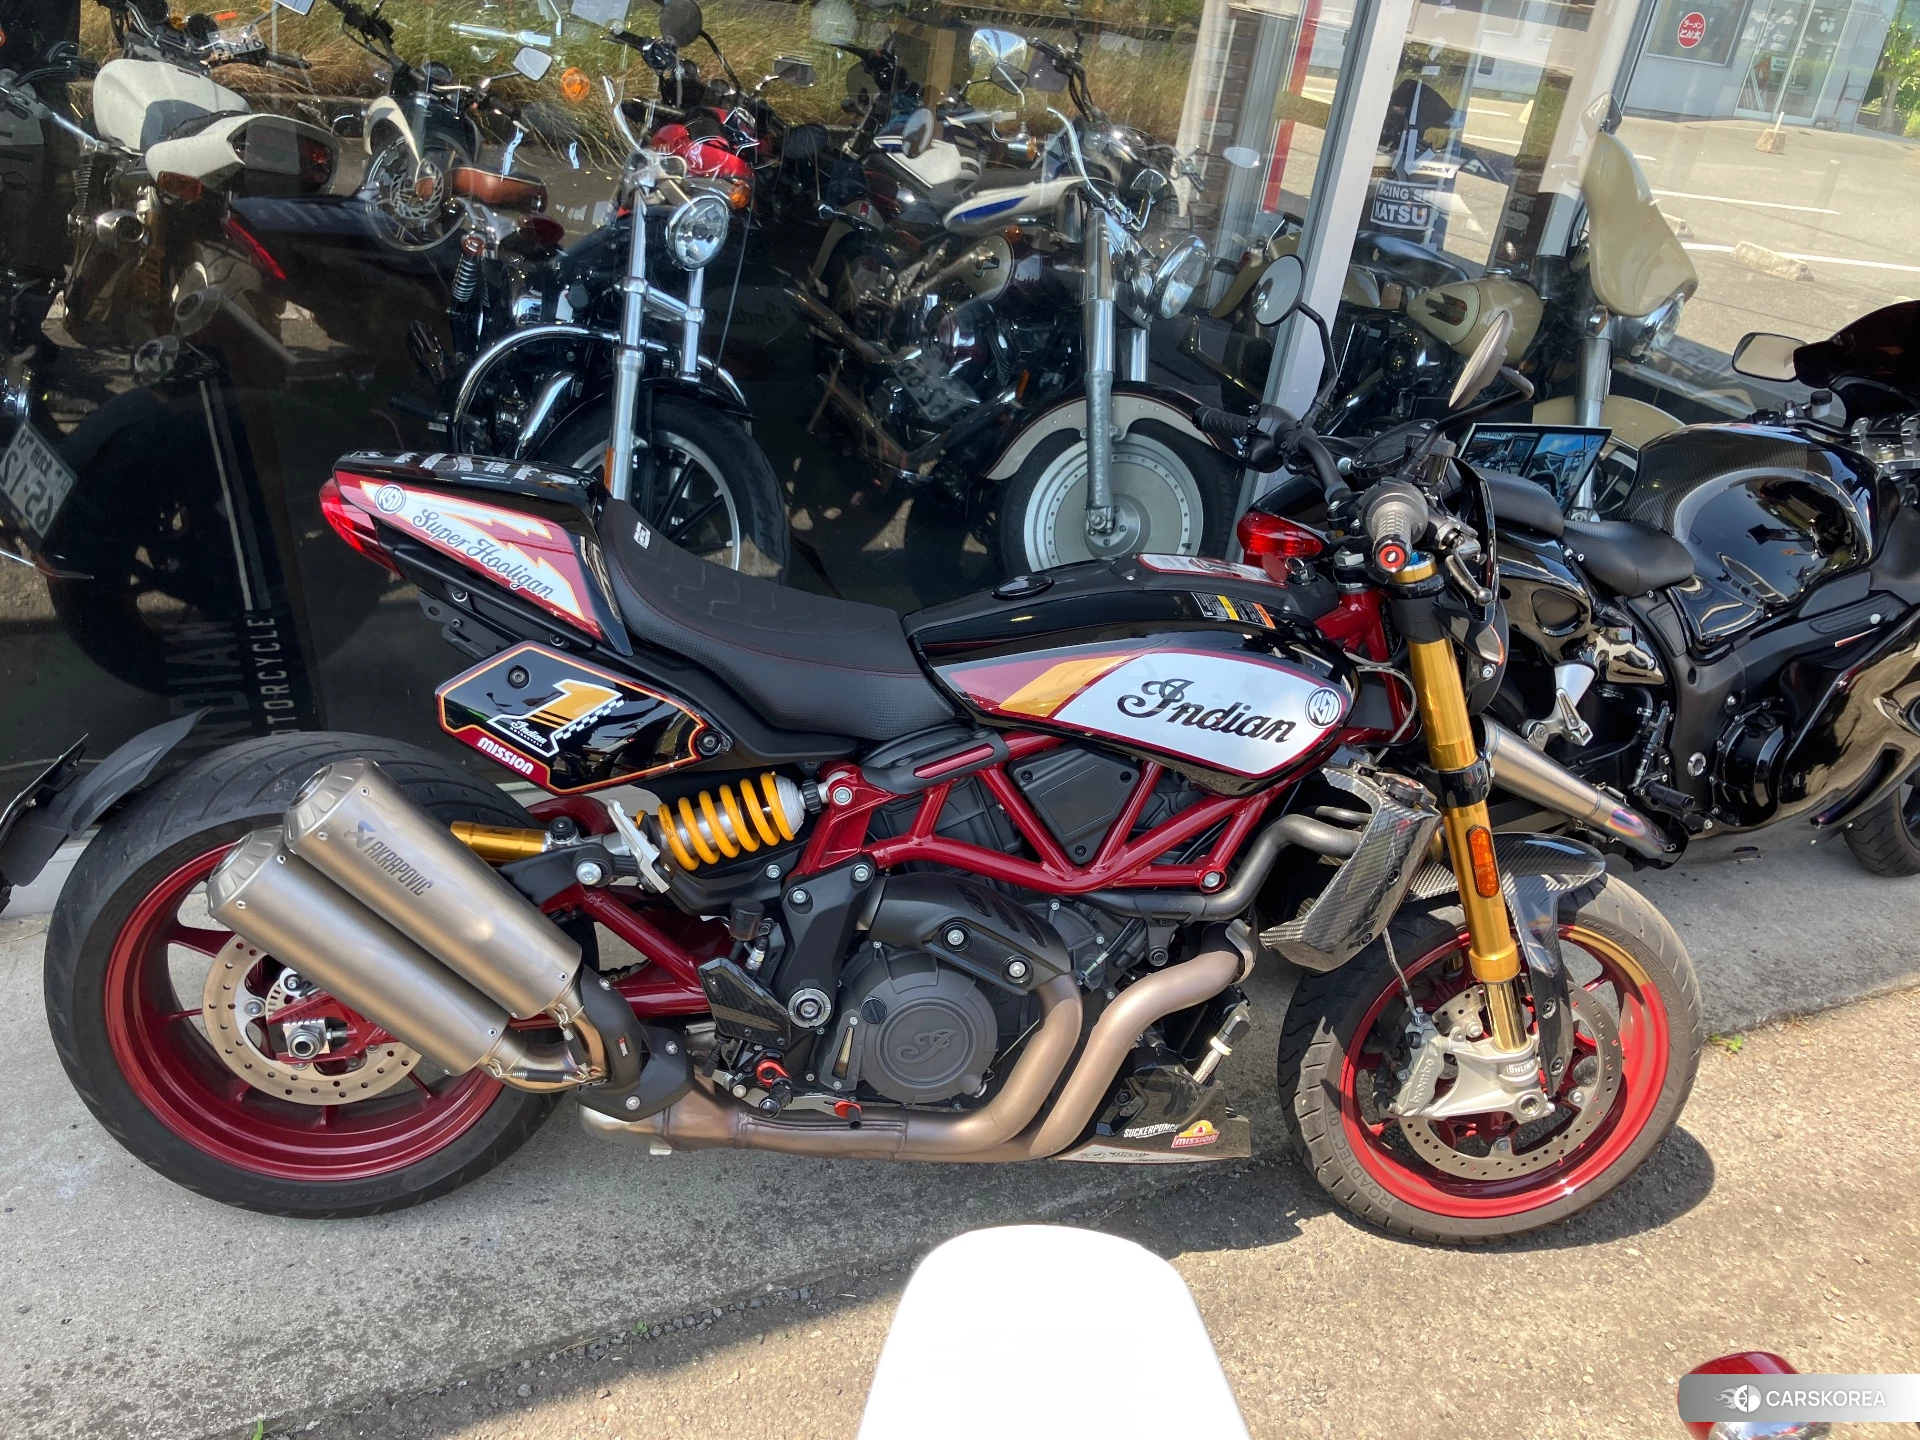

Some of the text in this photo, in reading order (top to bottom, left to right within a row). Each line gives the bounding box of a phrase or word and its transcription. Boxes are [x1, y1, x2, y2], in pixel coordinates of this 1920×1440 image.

[1682, 19, 1704, 29] ラーメン
[412, 508, 555, 600] Super Hooligan
[1117, 678, 1297, 743] Indian
[1410, 1058, 1434, 1105] brembo
